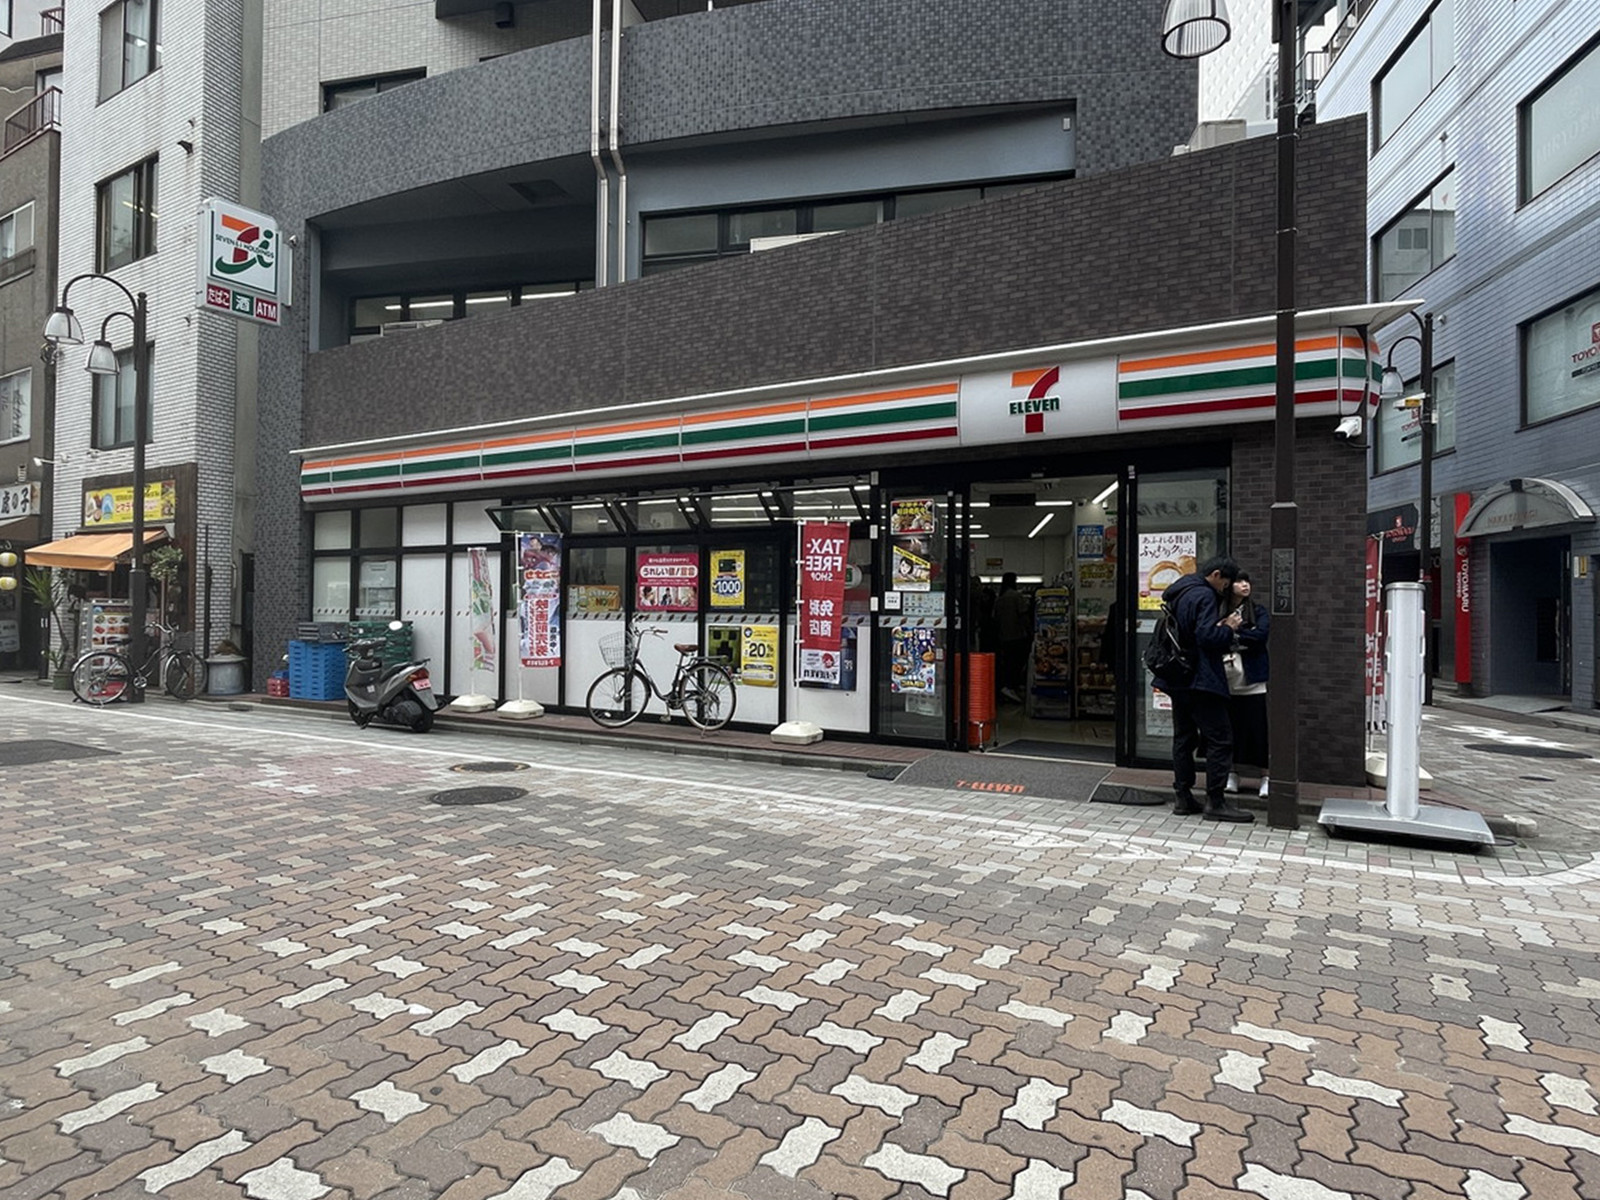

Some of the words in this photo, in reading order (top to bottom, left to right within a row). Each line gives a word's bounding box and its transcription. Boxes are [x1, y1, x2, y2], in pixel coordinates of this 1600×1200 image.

[208, 287, 230, 306] たばこ
[235, 294, 250, 312] 酒
[256, 302, 277, 319] ATM
[1571, 345, 1600, 363] TOYO
[716, 580, 741, 593] 1000
